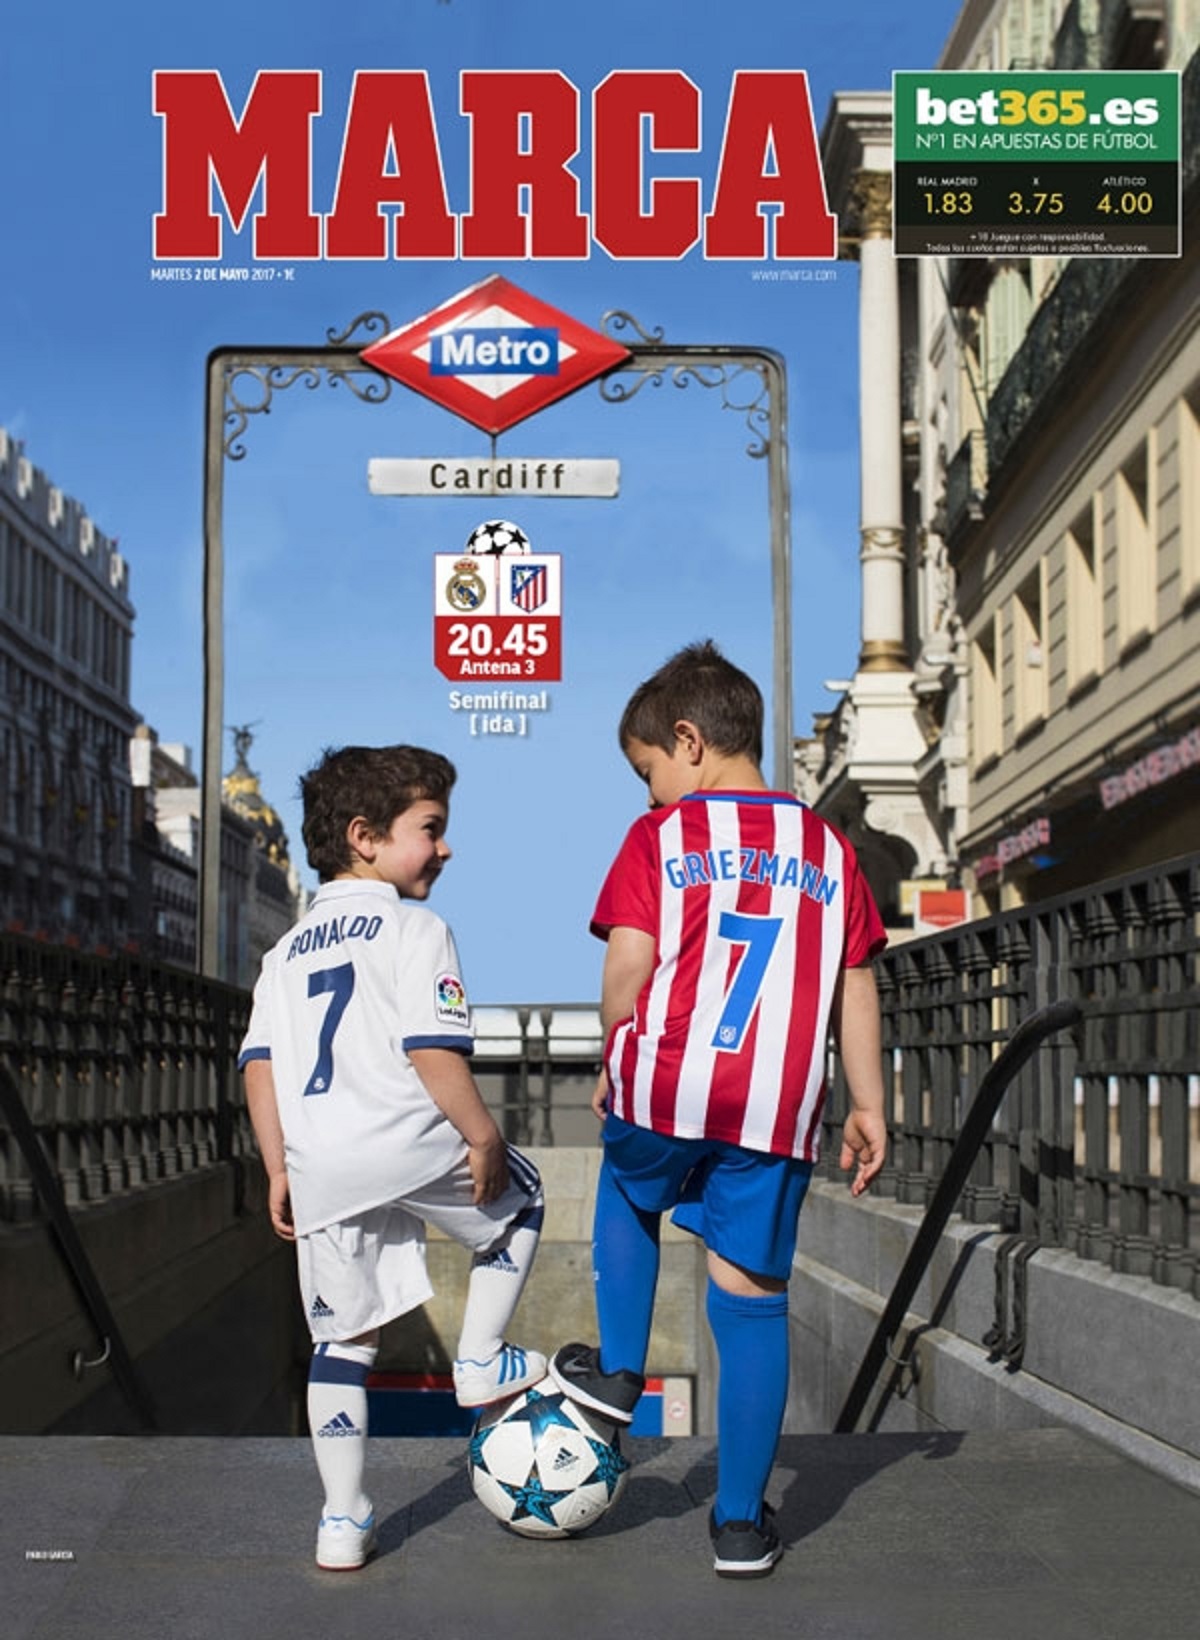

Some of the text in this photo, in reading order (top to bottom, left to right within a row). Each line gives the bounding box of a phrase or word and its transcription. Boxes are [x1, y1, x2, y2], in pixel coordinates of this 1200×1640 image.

[441, 334, 550, 366] Metro
[430, 464, 565, 489] Cardiff
[665, 849, 838, 906] GRIEZMANN
[287, 915, 383, 962] RONALDO
[709, 910, 785, 1053] 7
[303, 961, 356, 1097] 7
[317, 1428, 362, 1438] adidas
